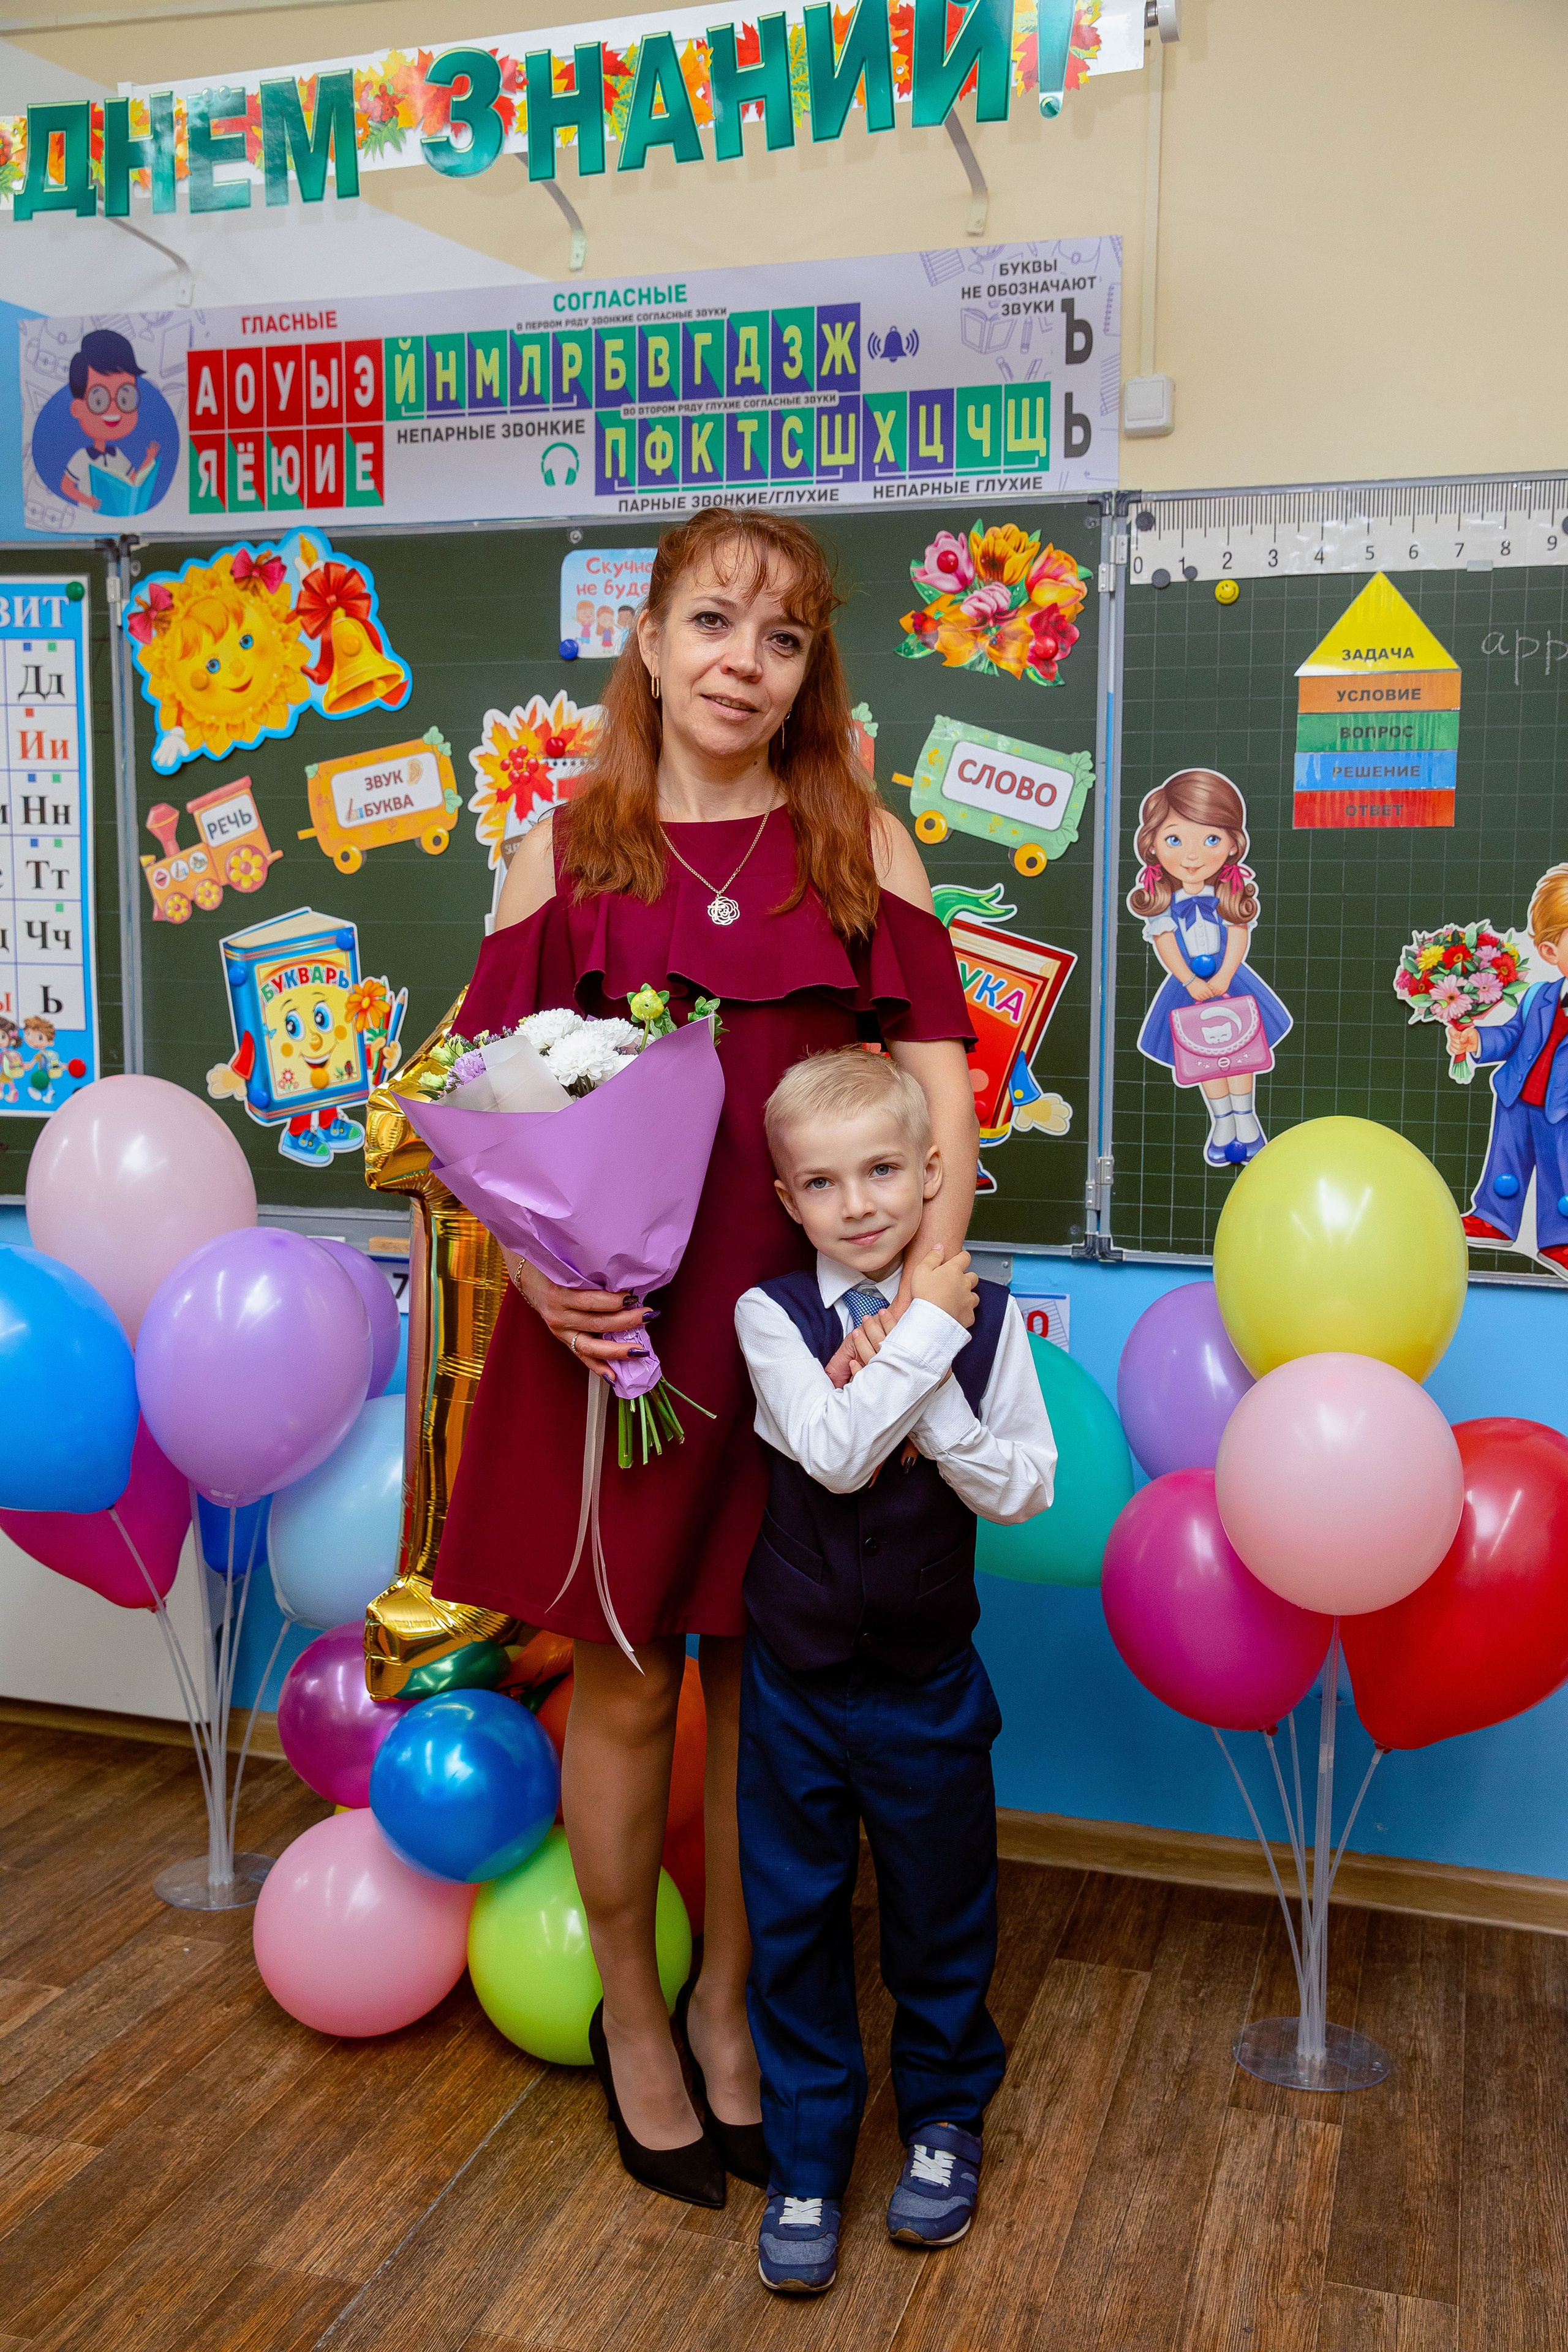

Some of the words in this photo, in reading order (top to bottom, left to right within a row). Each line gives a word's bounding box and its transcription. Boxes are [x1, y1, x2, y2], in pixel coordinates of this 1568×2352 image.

[1000, 259, 1057, 276] БУКВЫ
[553, 284, 688, 312] СОГЛАСНЫЕ
[962, 286, 981, 299] НЕ
[987, 276, 1096, 297] ОБОЗНАЧАЮТ
[1001, 300, 1054, 316] ЗВУКИ
[241, 310, 337, 334] ГЛАСНЫЕ
[525, 320, 562, 330] ПЕРВОМ
[565, 318, 589, 328] РЯДУ
[591, 314, 634, 325] ЗВОНКИЕ
[636, 311, 693, 322] СОГЛАСНЫЕ
[696, 308, 727, 317] ЗВУКИ
[638, 405, 675, 415] ВТОРОМ
[678, 403, 703, 412] РЯДУ
[705, 401, 740, 410] ГЛУХИЕ
[744, 396, 802, 407] СОГЛАСНЫЕ
[804, 394, 836, 404] ЗВУКИ
[397, 424, 496, 445] НЕПАРНЫЕ
[502, 419, 586, 438] ЗВОНКИЕ
[873, 480, 970, 499] НЕПАРНЫЕ
[976, 477, 1042, 492] ГЛУХИЕ
[619, 497, 686, 512] ПАРНЫЕ
[1134, 556, 1143, 574] 0
[1178, 556, 1186, 575] 1
[1222, 551, 1232, 570] 2
[1268, 549, 1278, 567] 3
[1314, 546, 1324, 565] 4
[1365, 545, 1375, 560] 5
[1409, 544, 1419, 559] 6
[1455, 542, 1464, 558] 7
[1500, 540, 1511, 556] 8
[1547, 535, 1558, 551] 9
[576, 582, 597, 596] не
[1341, 646, 1414, 662] ЗАДАЧА
[1336, 688, 1422, 703] УСЛОВИЕ
[1340, 726, 1414, 741] ВОПРОС
[364, 770, 403, 791] ЗВУК
[1333, 766, 1421, 778] РЕШЕНИЕ
[958, 759, 1057, 807] СЛОВО
[364, 794, 414, 817] БУКВА
[1345, 804, 1404, 818] ОТВЕТ
[207, 809, 252, 840] РЕЧЬ
[260, 966, 349, 1002] БУКВАРЬ
